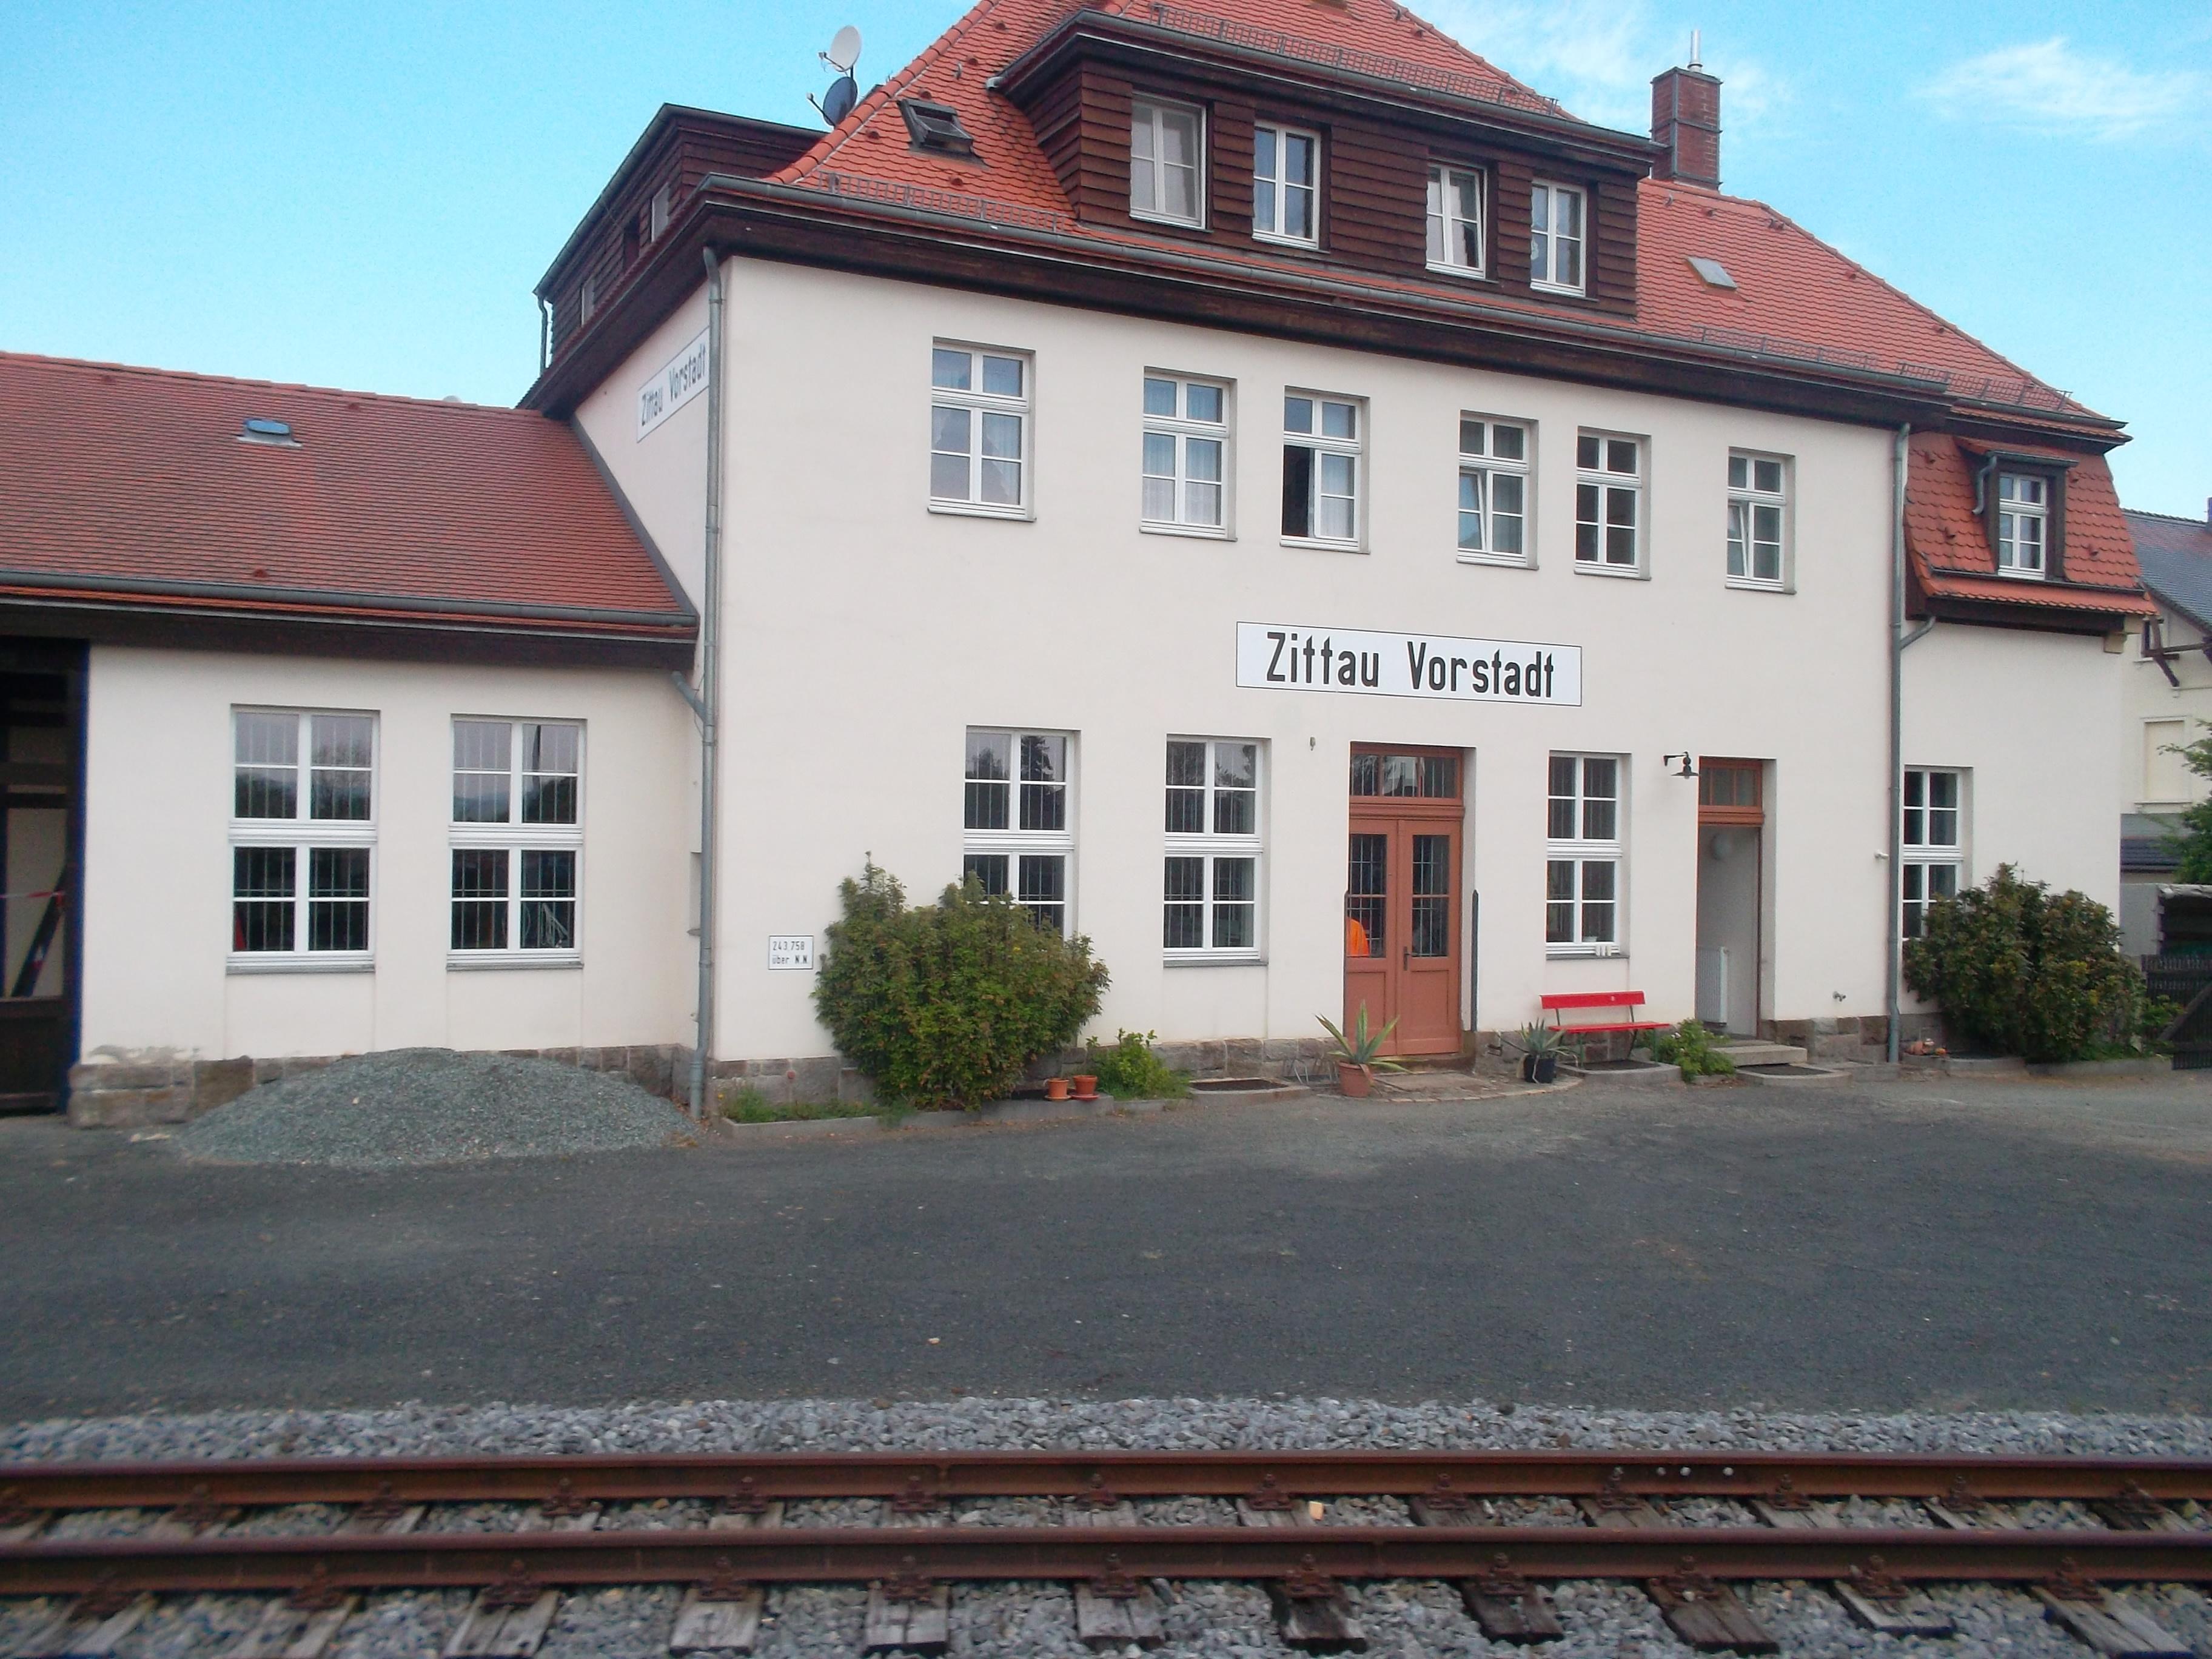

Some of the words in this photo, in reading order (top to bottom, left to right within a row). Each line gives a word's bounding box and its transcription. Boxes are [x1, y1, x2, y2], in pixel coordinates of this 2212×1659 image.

[669, 344, 705, 402] Vorstadt
[1267, 632, 1379, 687] Zittau
[1407, 641, 1553, 697] Vorstadt
